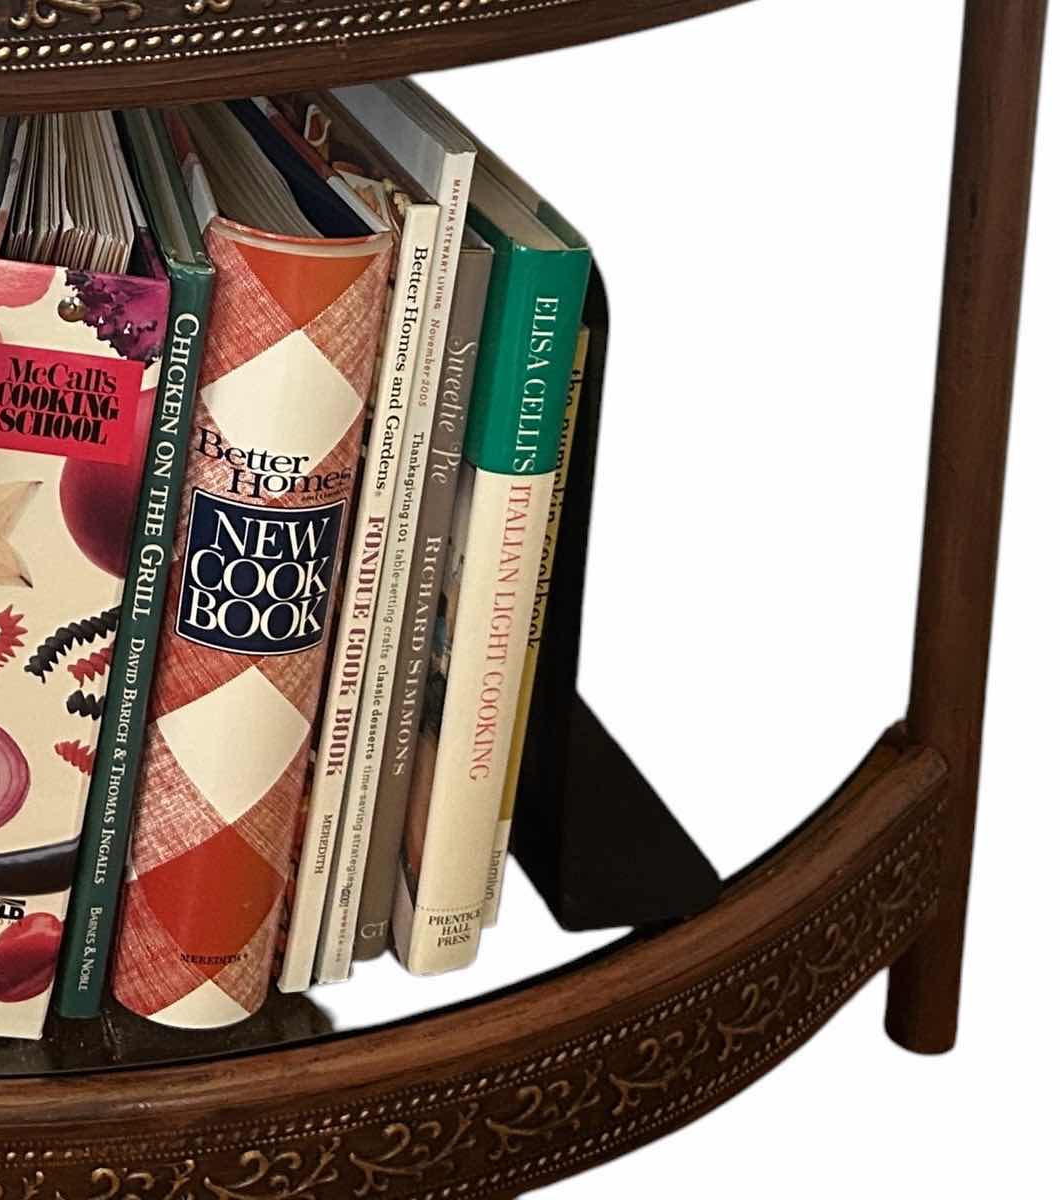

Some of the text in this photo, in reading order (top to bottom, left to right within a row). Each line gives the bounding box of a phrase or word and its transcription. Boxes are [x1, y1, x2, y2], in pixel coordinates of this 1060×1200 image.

[418, 178, 462, 408] MARTHA STEWART LIVING November 2005
[6, 356, 117, 394] McCall's
[375, 245, 429, 491] Better Homes and Gardens
[131, 312, 200, 621] CHICKEN ON THE GRILL
[196, 426, 310, 475] Better
[209, 509, 331, 561] NEW
[190, 548, 331, 602] COOK
[184, 584, 323, 642] BOOK
[467, 482, 533, 783] ITALIAN LIGHT COOKING
[326, 514, 386, 778] FONDUE COOK BOOK
[93, 637, 146, 886] DAVID BARICH & THOMAS INGALLS
[314, 813, 333, 875] MEREDITH
[427, 908, 482, 927] PRENTICE
[436, 932, 472, 949] PRESS
[440, 920, 472, 938] HALL
